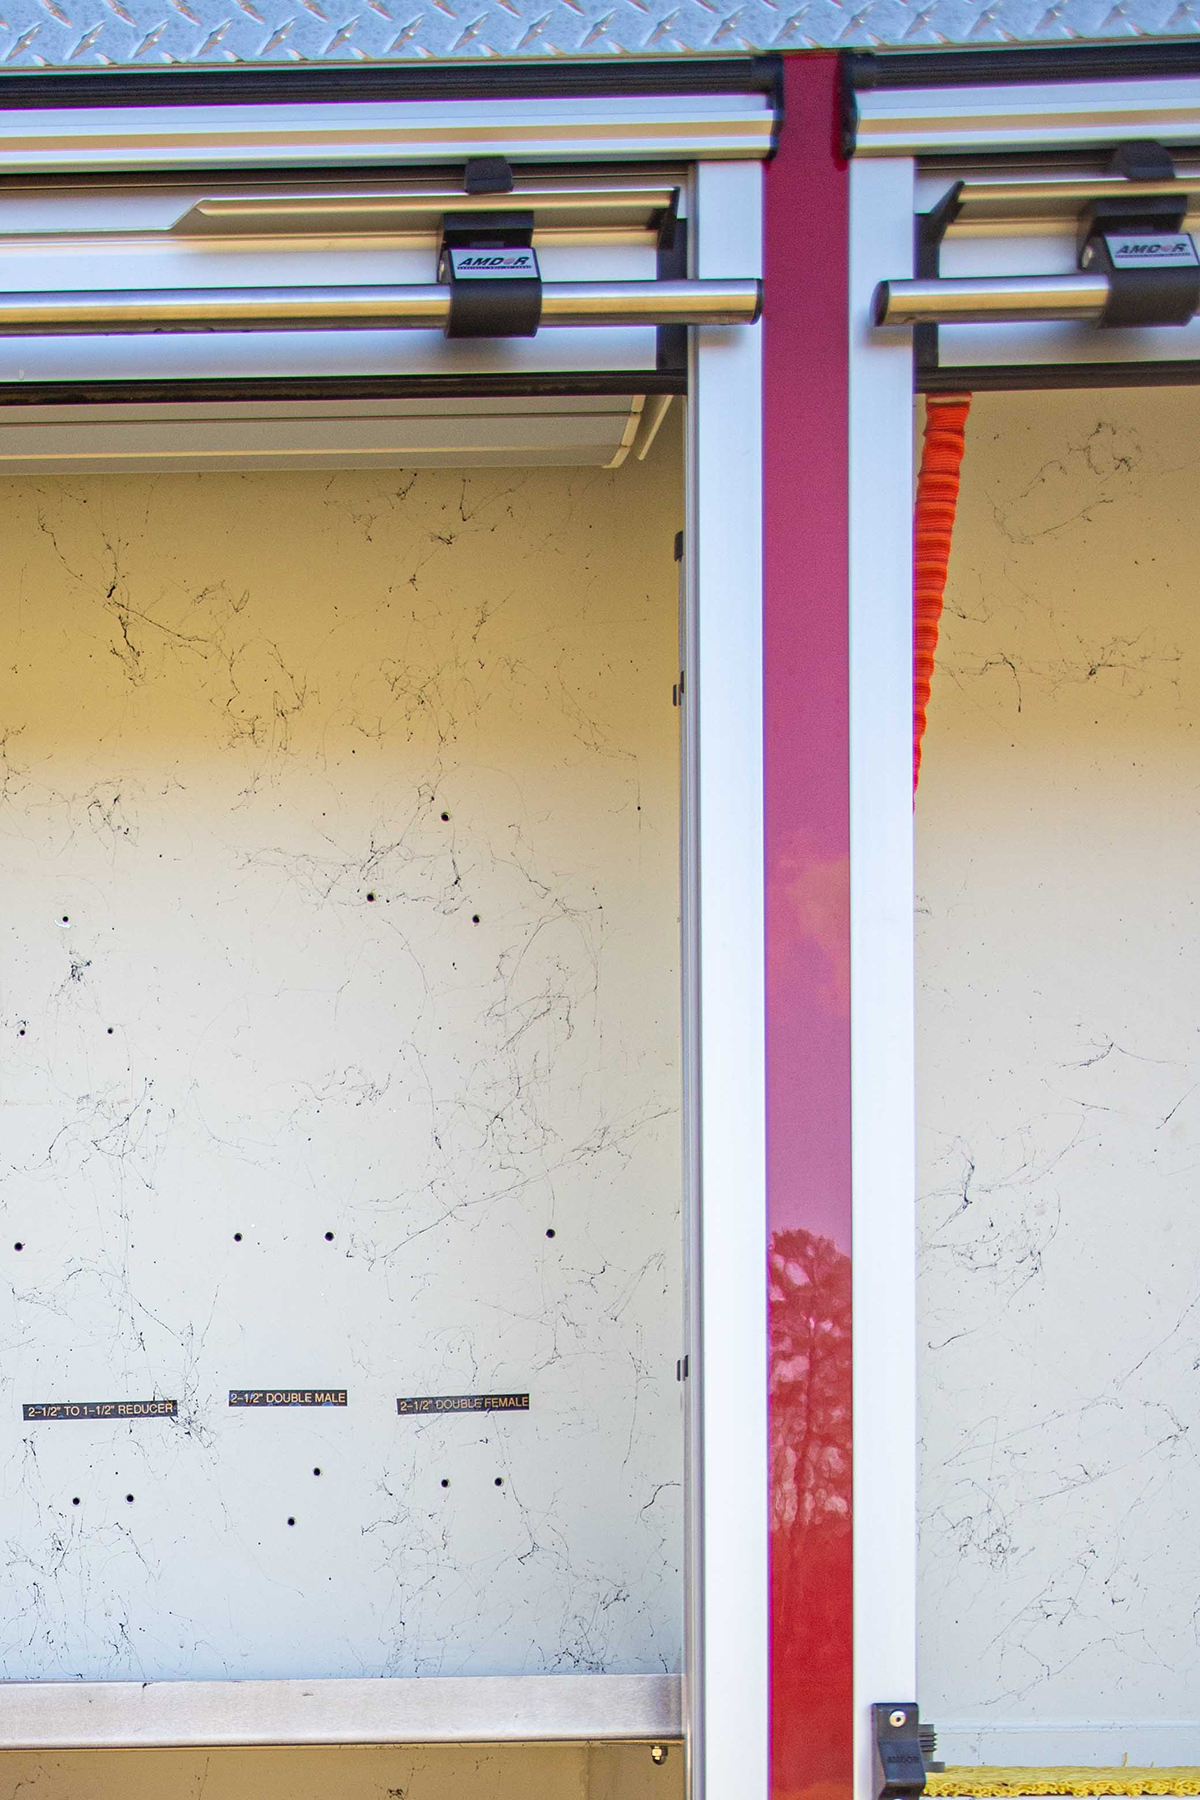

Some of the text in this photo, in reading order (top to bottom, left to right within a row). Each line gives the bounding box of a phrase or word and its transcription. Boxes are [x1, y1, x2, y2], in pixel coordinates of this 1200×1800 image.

[266, 1392, 312, 1403] DOUBLE
[314, 1392, 346, 1403] MALE
[436, 1398, 482, 1410] DOUBLE
[484, 1396, 529, 1408] FEMALE
[64, 1406, 80, 1416] TO
[118, 1403, 174, 1415] REDUCER
